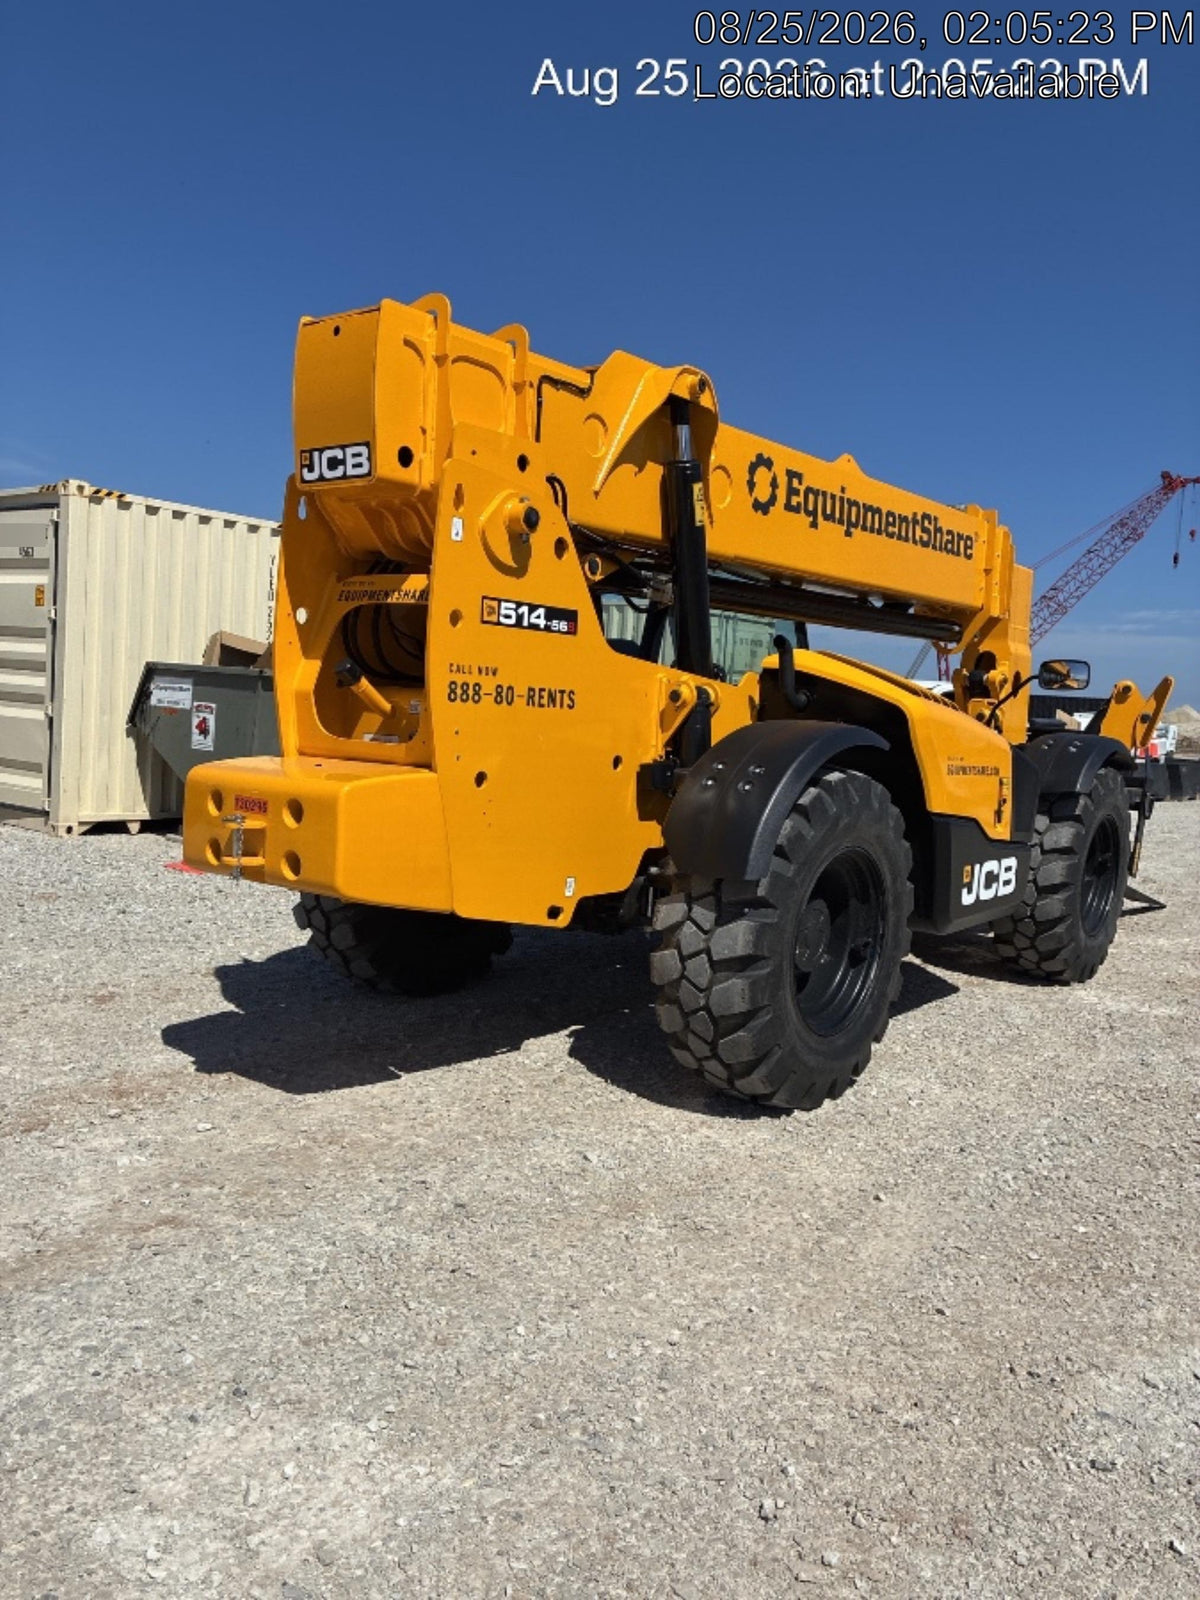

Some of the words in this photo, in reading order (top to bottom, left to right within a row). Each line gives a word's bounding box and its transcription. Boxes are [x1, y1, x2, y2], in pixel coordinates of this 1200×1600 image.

[301, 445, 371, 481] JCB
[783, 467, 974, 560] EquipmentShare
[449, 662, 473, 675] CALL
[477, 665, 498, 677] NOW
[447, 680, 576, 710] 888-80-RENTS
[961, 856, 1018, 906] JCB
